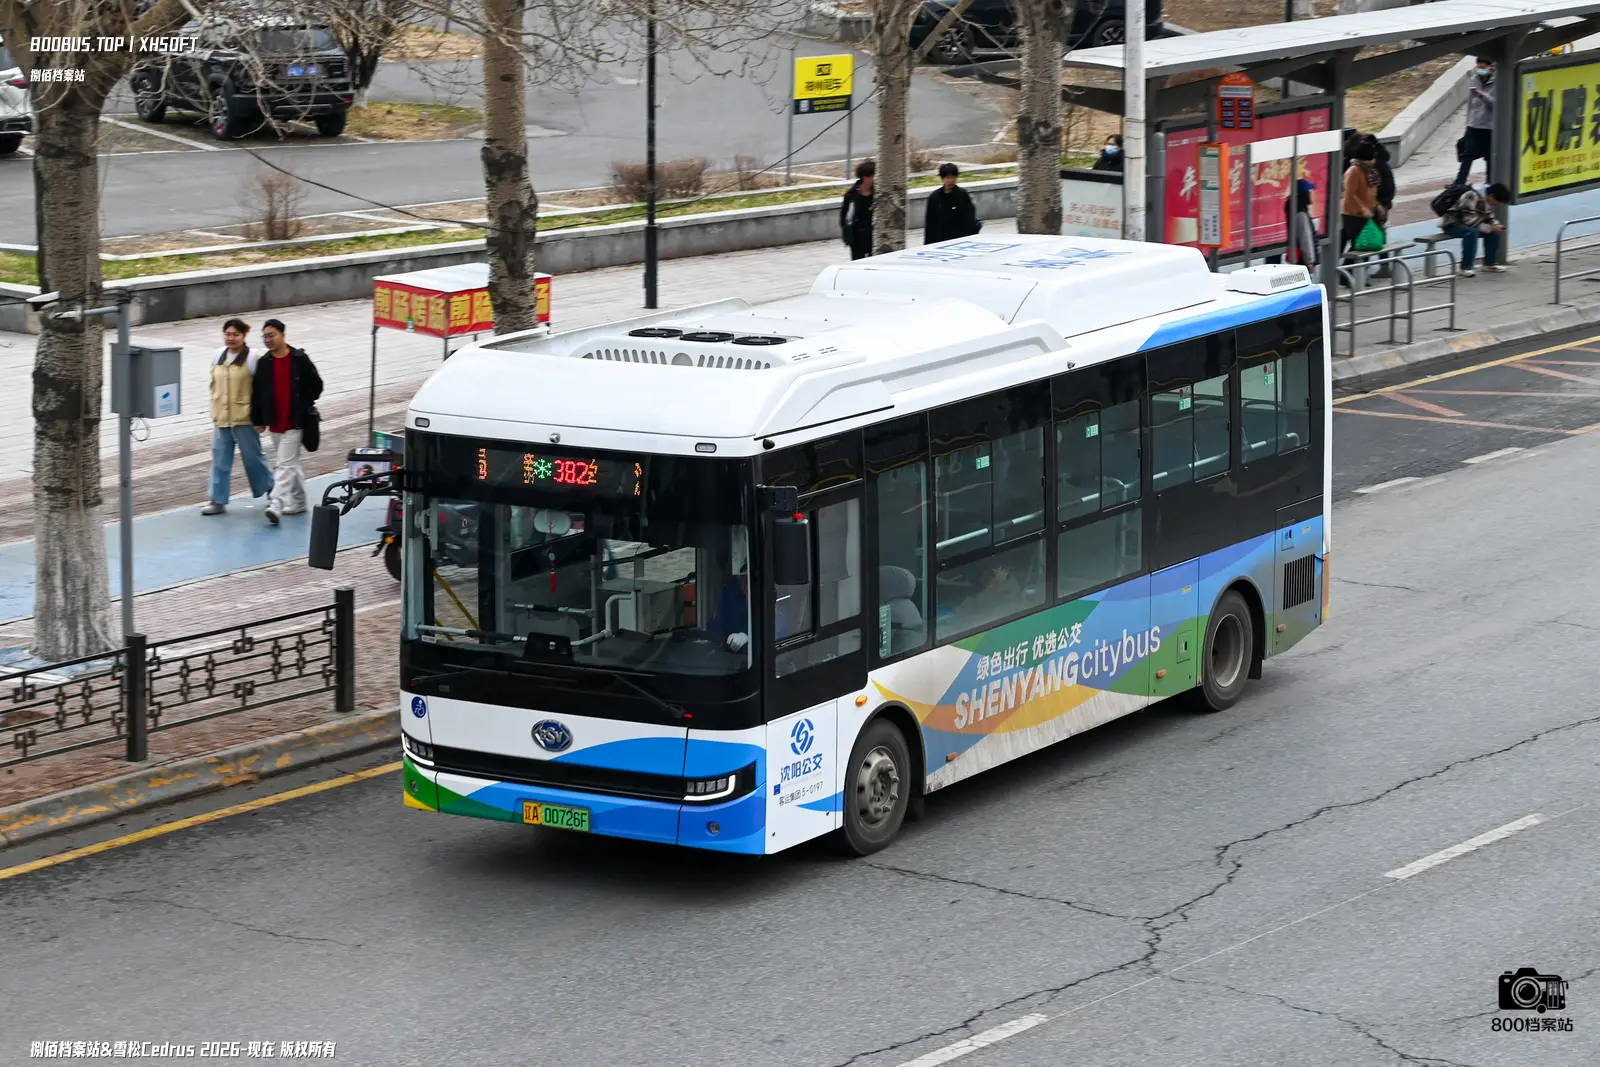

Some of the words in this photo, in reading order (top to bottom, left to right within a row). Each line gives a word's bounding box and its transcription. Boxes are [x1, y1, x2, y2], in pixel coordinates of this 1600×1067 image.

[553, 459, 589, 484] 382
[976, 640, 1029, 681] 绿色出行
[1032, 622, 1083, 661] 优选公交
[954, 651, 1079, 730] SHENYANG
[1080, 625, 1161, 679] citybus
[780, 753, 823, 783] 沈阳公交
[801, 780, 824, 798] 5-0197
[544, 807, 587, 829] 00726F
